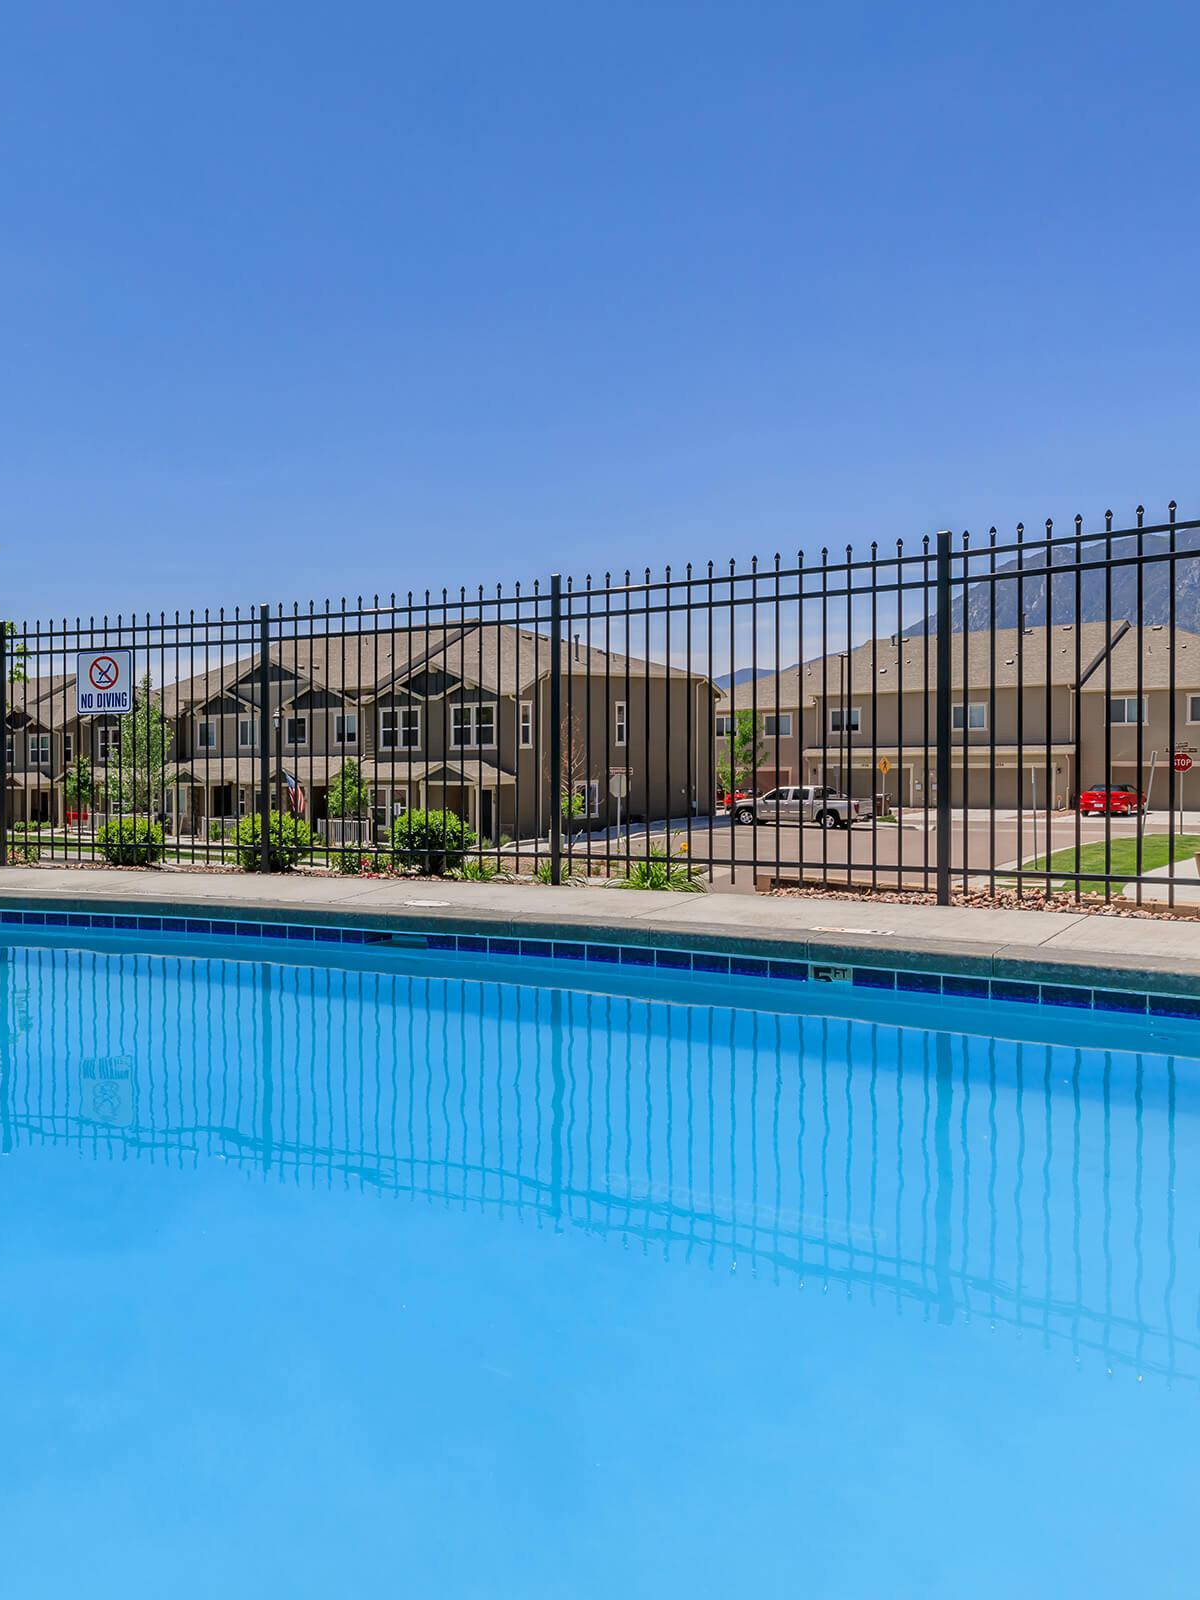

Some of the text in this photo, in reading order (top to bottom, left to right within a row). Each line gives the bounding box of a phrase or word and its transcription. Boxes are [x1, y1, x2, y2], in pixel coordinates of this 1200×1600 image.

[81, 692, 127, 708] NO DIVING
[813, 967, 847, 982] 5 FT
